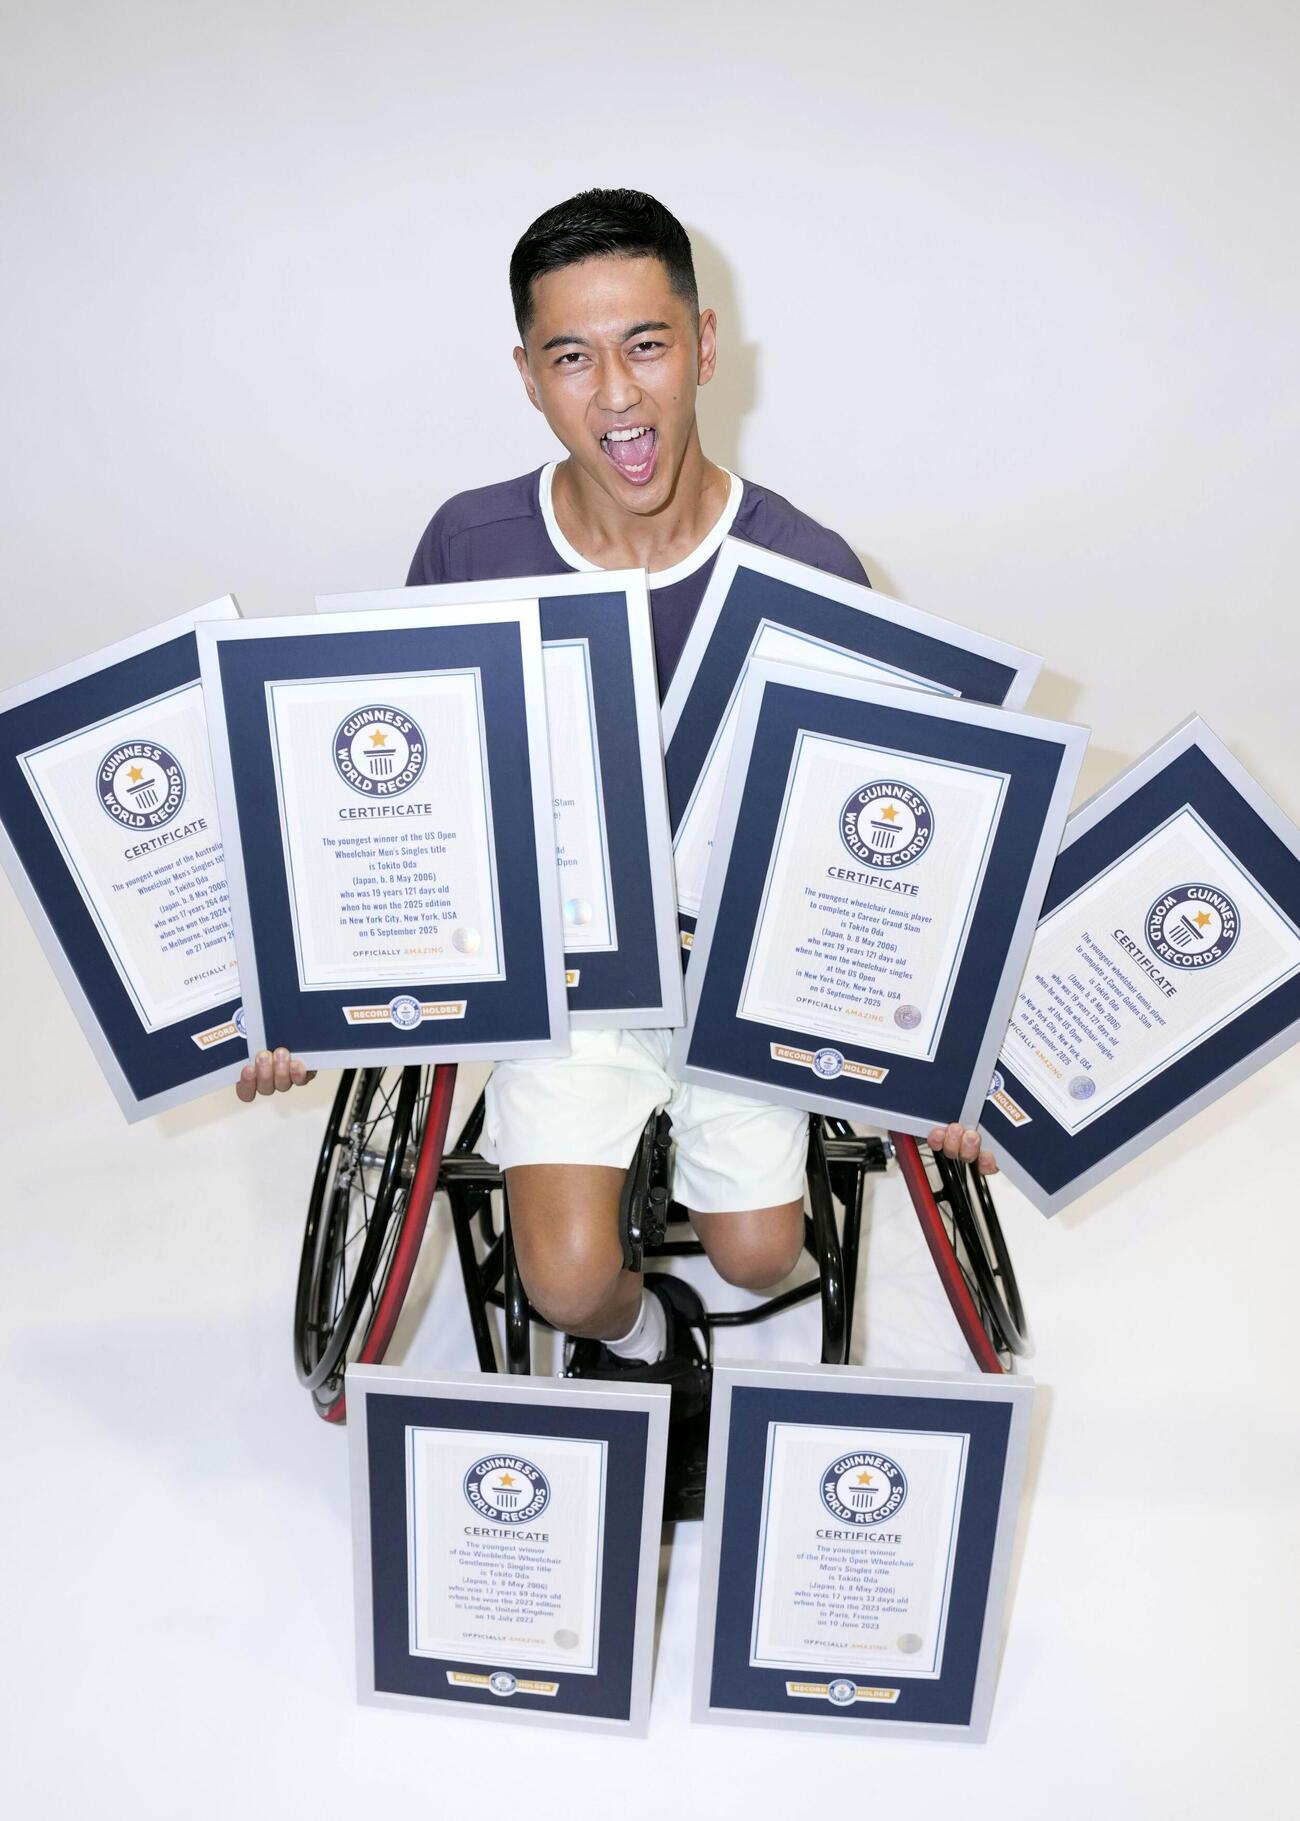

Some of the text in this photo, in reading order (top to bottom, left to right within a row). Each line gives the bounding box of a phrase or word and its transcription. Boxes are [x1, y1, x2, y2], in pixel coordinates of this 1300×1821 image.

[344, 710, 412, 736] GUINNESS
[102, 745, 161, 781] GUINNESS
[338, 744, 422, 793] WORLD RECORDS
[104, 766, 181, 826] WORLD RECORDS
[554, 798, 575, 807] Slam
[859, 785, 926, 815] GUINNESS
[339, 803, 432, 819] CERTIFICATE
[124, 818, 207, 859] CERTIFICATE
[322, 831, 457, 847] The youngest winner of the US Open
[845, 812, 928, 866] WORLD RECORDS
[335, 845, 447, 859] Wheelchair Men's Singles title
[377, 861, 401, 870] Tokito
[402, 860, 417, 869] Oda
[111, 883, 125, 892] The
[125, 871, 153, 889] youngest
[153, 863, 174, 876] winner
[175, 858, 183, 867] of
[182, 855, 195, 864] the
[137, 877, 172, 895] Wheelchair
[190, 860, 215, 874] Singles
[352, 872, 437, 886] (Japan, b. 8 May 2006)
[828, 867, 919, 895] CERTIFICATE
[340, 890, 355, 899] who
[372, 888, 381, 897] 19
[382, 889, 403, 898] years
[404, 886, 417, 896] 121
[418, 886, 436, 896] days
[437, 885, 450, 894] old
[339, 911, 458, 925] in New York City, New York, USA
[341, 903, 360, 912] when
[361, 903, 371, 911] he
[389, 901, 402, 910] the
[403, 899, 423, 909] 2025
[425, 899, 451, 908] edition
[804, 887, 933, 924] The youngest wheelchair tennis player
[809, 901, 818, 909] to
[818, 904, 850, 917] complete
[857, 912, 881, 924] Career
[881, 918, 903, 929] Grand
[903, 922, 921, 933] Slam
[1187, 888, 1235, 938] GUINNESS
[369, 928, 376, 937] 6
[376, 927, 417, 937] September
[418, 925, 439, 935] 2025
[840, 919, 884, 937] is Tokito Oda
[1150, 896, 1221, 965] WORLD RECORDS
[160, 945, 169, 953] in
[352, 946, 444, 957] OFFICIALLY AMAZING
[183, 964, 226, 986] OFFICIALLY
[795, 946, 913, 980] when he won the wheelchair singles
[826, 965, 876, 983] at the US Open
[1114, 929, 1177, 997] CERTIFICATE
[1075, 944, 1084, 954] to
[1081, 952, 1105, 977] complete
[1106, 978, 1125, 998] Career
[1122, 996, 1141, 1016] Golden
[1138, 1013, 1153, 1029] Slam
[1081, 931, 1167, 1026] The youngest wheelchair tennis player
[1088, 976, 1120, 1012] is Tokito Oda
[353, 1005, 459, 1019] RECORD HOLDER
[796, 996, 883, 1022] OFFICIALLY AMAZING
[203, 1025, 235, 1043] RECORD
[777, 1048, 812, 1063] RECORD
[844, 1063, 879, 1078] HOLDER
[1034, 1050, 1063, 1079] AMAZING
[995, 1093, 1021, 1119] HOLDER
[476, 1458, 539, 1480] GUINNESS
[834, 1455, 897, 1477] GUINNESS
[468, 1483, 546, 1521] WORLD RECORDS
[825, 1482, 903, 1523] WORLD RECORDS
[464, 1526, 548, 1541] CERTIFICATE
[816, 1529, 901, 1543] CERTIFICATE
[455, 1673, 488, 1683] RECORD
[518, 1681, 551, 1691] HOLDER
[793, 1684, 827, 1694] RECORD
[857, 1688, 891, 1699] HOLDER
